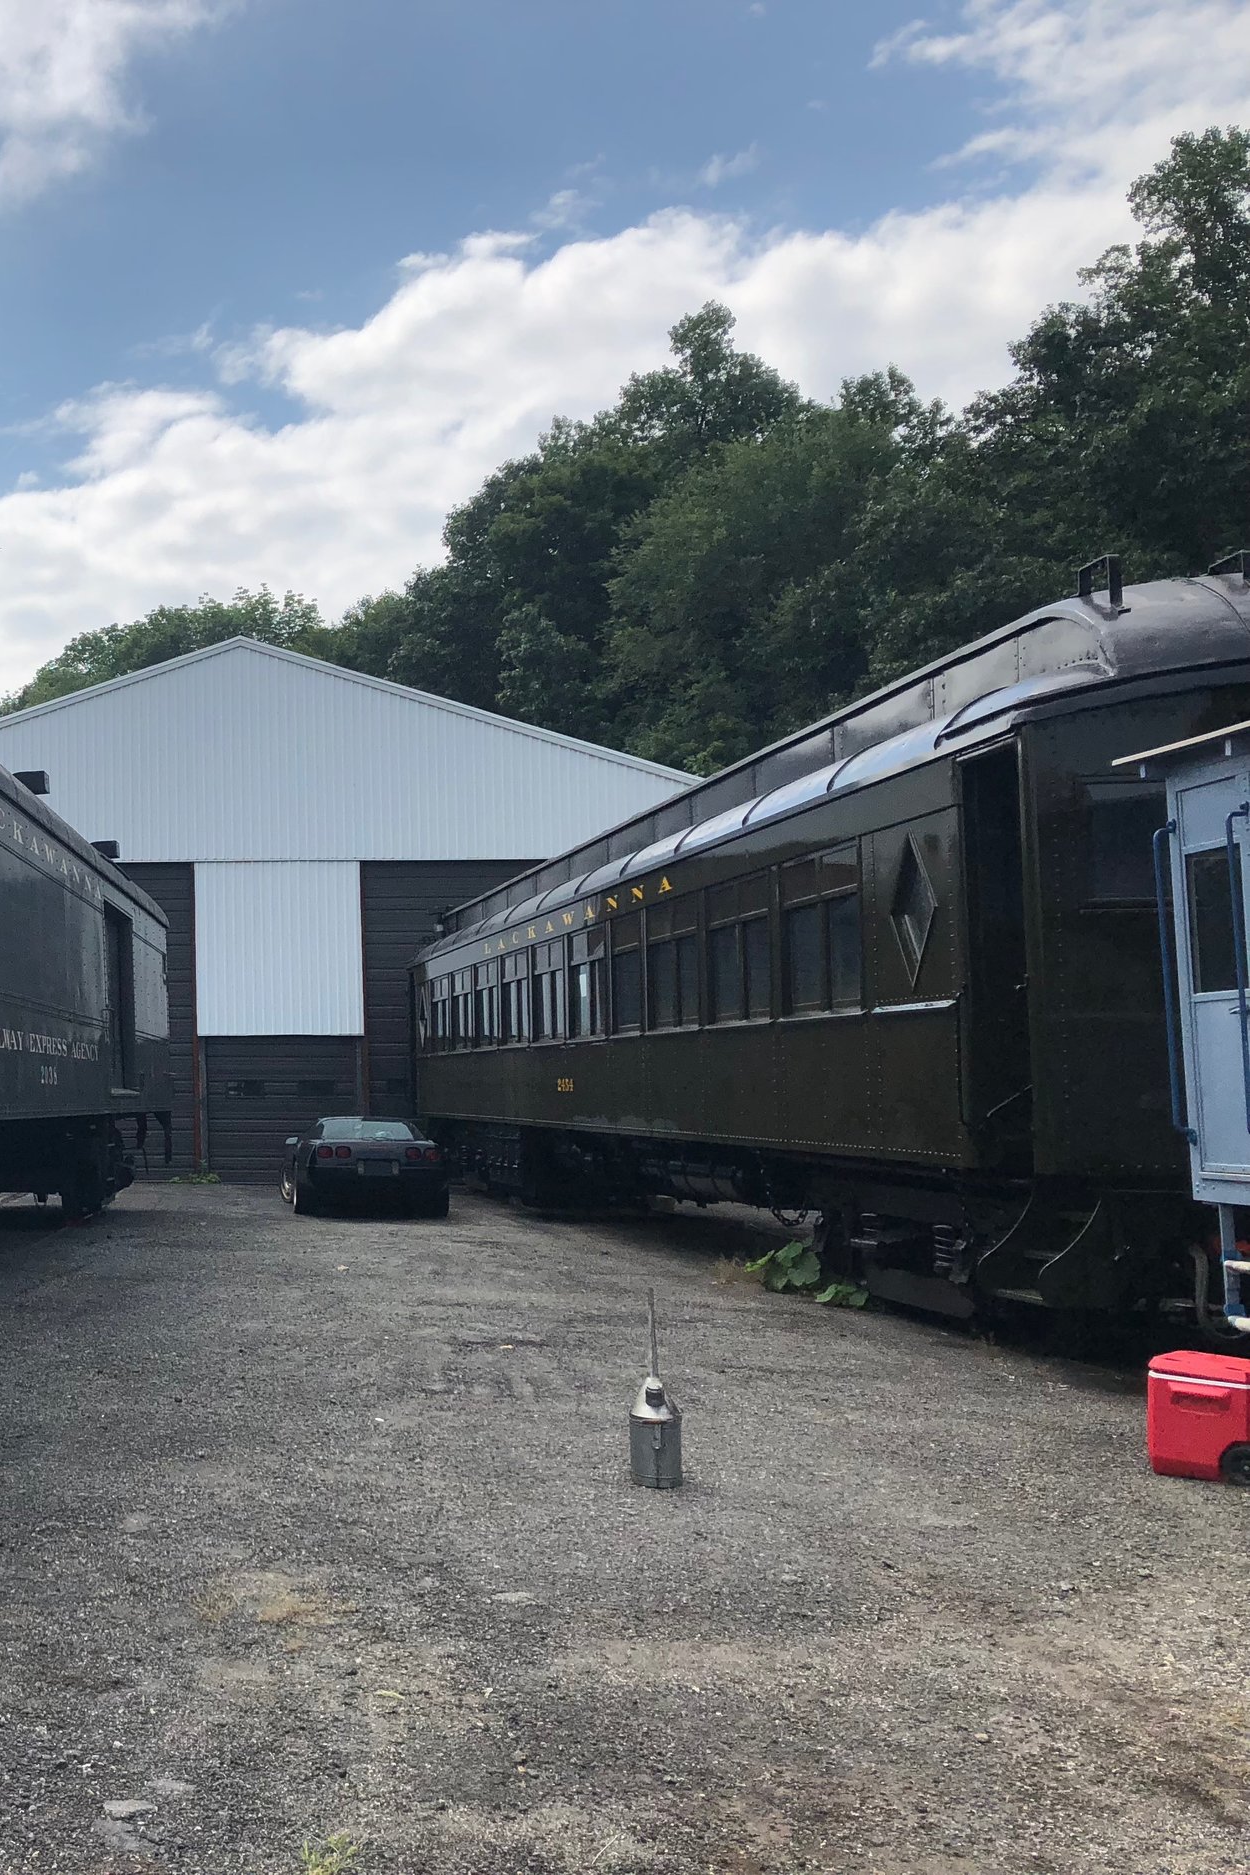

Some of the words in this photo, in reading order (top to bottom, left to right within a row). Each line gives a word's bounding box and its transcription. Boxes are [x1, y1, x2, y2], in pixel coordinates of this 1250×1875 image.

[483, 876, 673, 955] LACKAWANNA
[29, 1033, 68, 1057] EXPRESS
[71, 1041, 99, 1062] AGENCY
